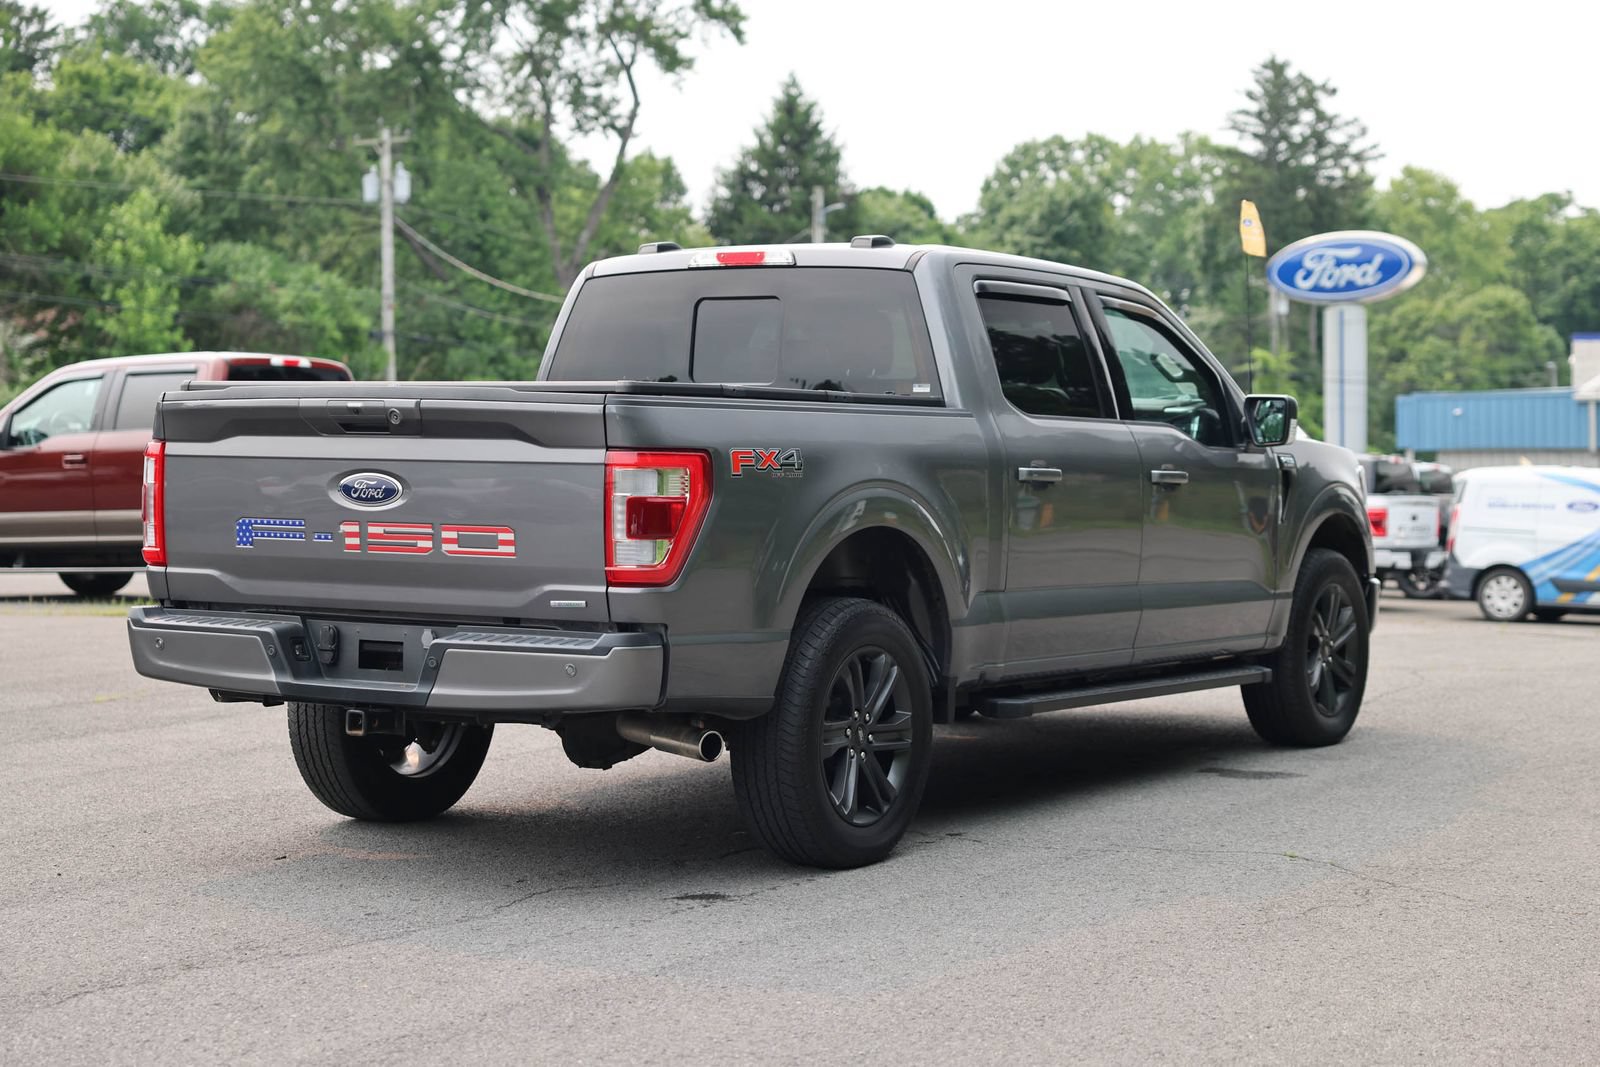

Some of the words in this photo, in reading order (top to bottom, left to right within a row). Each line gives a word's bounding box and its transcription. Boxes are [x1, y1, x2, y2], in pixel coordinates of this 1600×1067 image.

[1294, 246, 1384, 291] Ford
[729, 447, 803, 478] FX4
[351, 479, 386, 499] Ford
[236, 517, 516, 558] F-150
